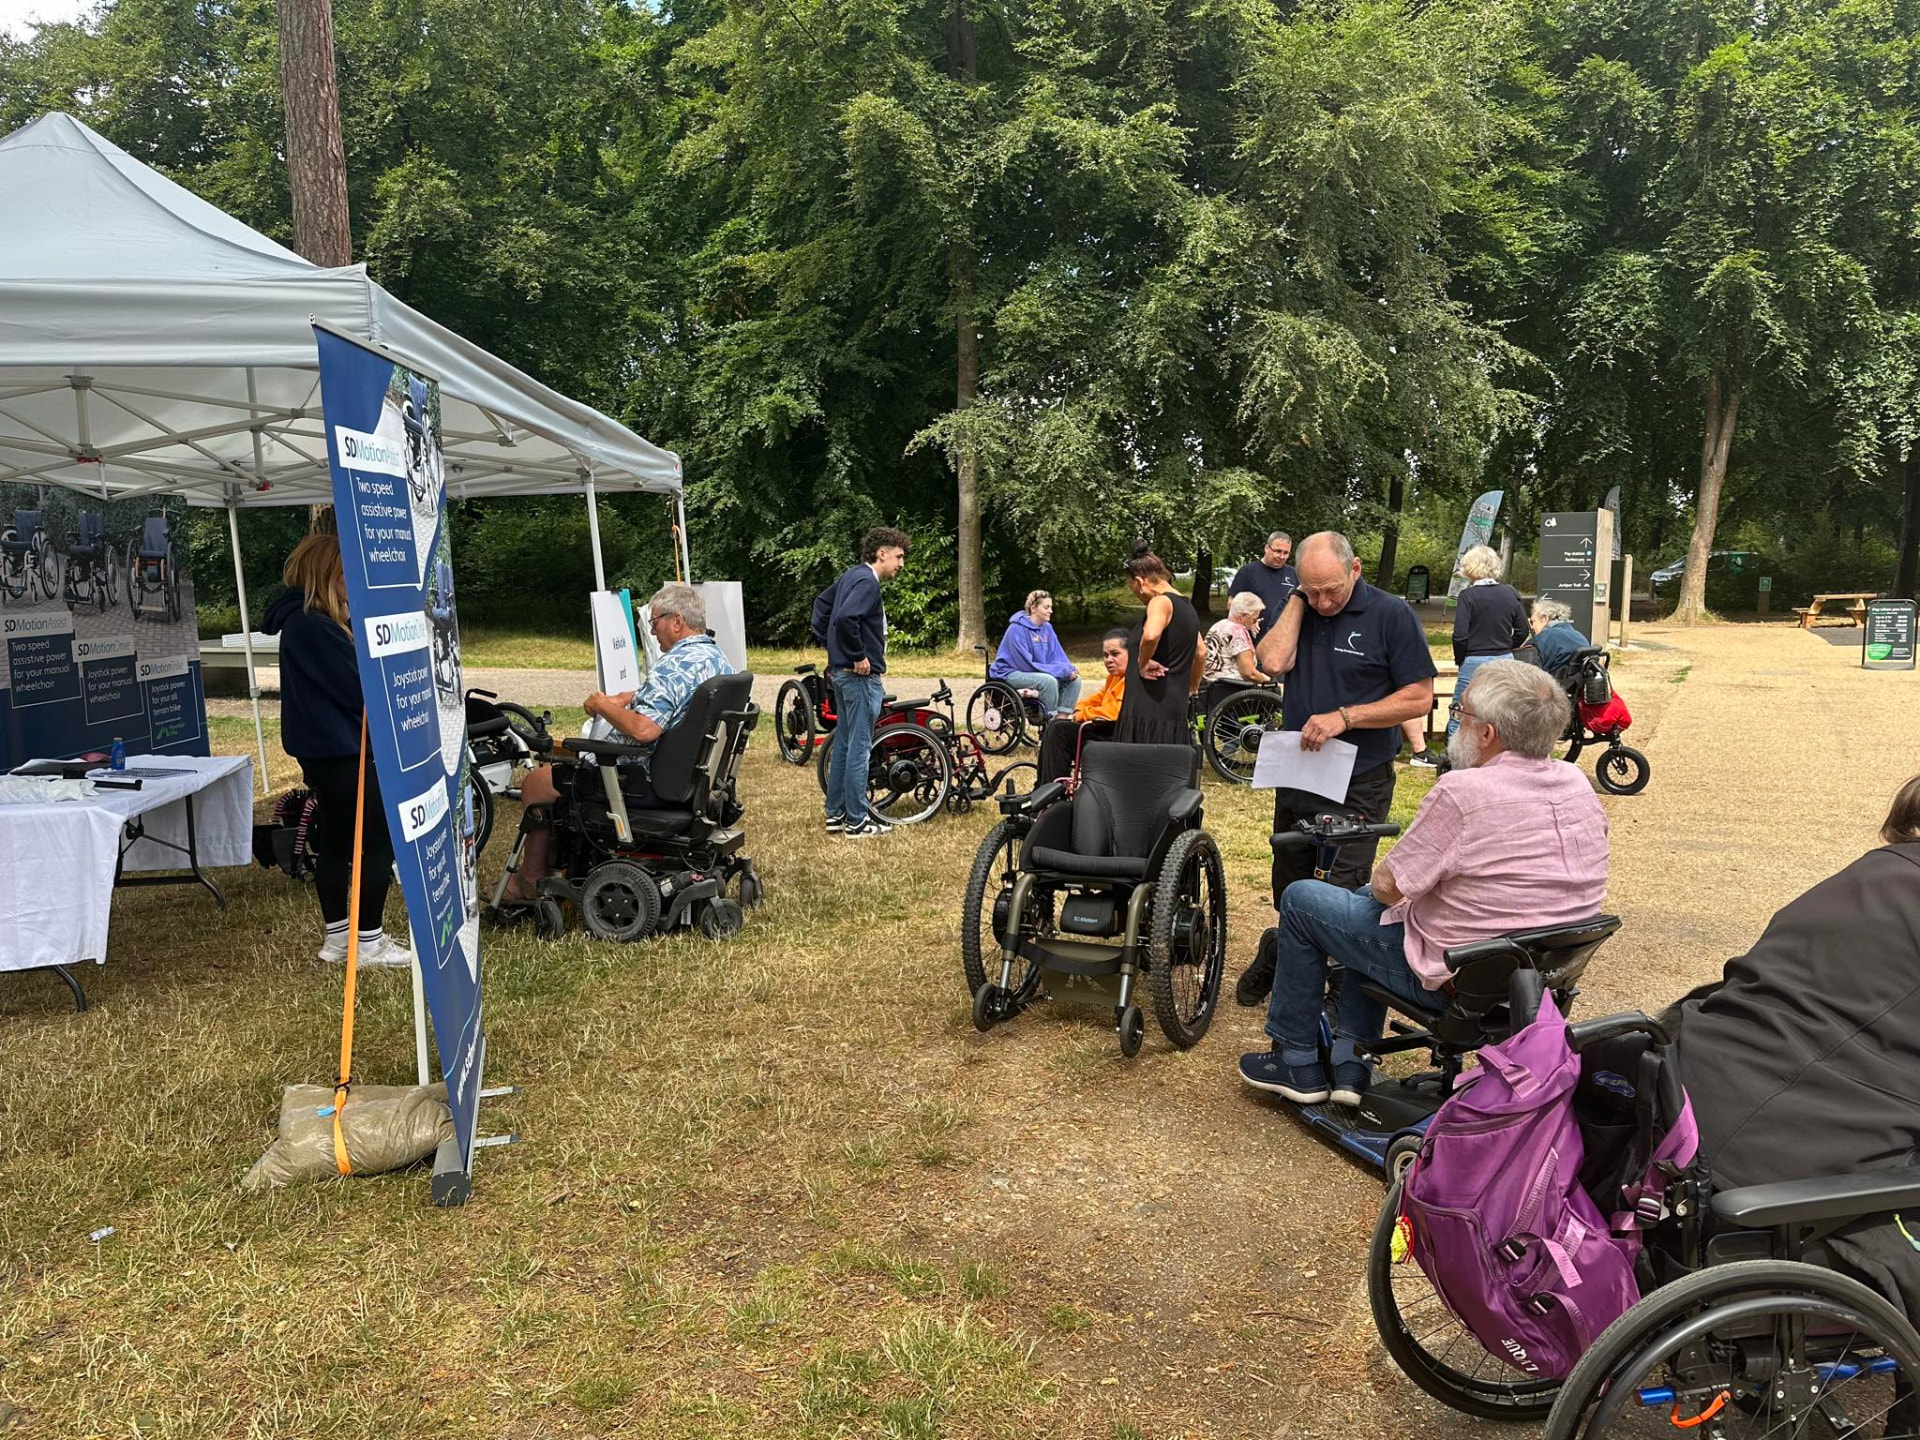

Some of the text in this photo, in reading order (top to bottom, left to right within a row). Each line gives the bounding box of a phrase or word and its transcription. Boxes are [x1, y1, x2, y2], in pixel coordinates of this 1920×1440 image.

[356, 476, 394, 499] Two speed
[361, 501, 393, 518] assistive
[364, 524, 375, 540] for
[376, 527, 394, 544] your
[368, 548, 406, 563] wheelchair
[11, 639, 50, 653] Two speed
[12, 652, 67, 666] assistive power
[14, 664, 71, 681] for your manual
[88, 666, 128, 680] Joystick power
[15, 679, 56, 693] wheelchair
[88, 677, 133, 692] for your manual
[89, 692, 121, 704] wheelchair
[396, 694, 408, 710] for
[170, 704, 182, 712] trike
